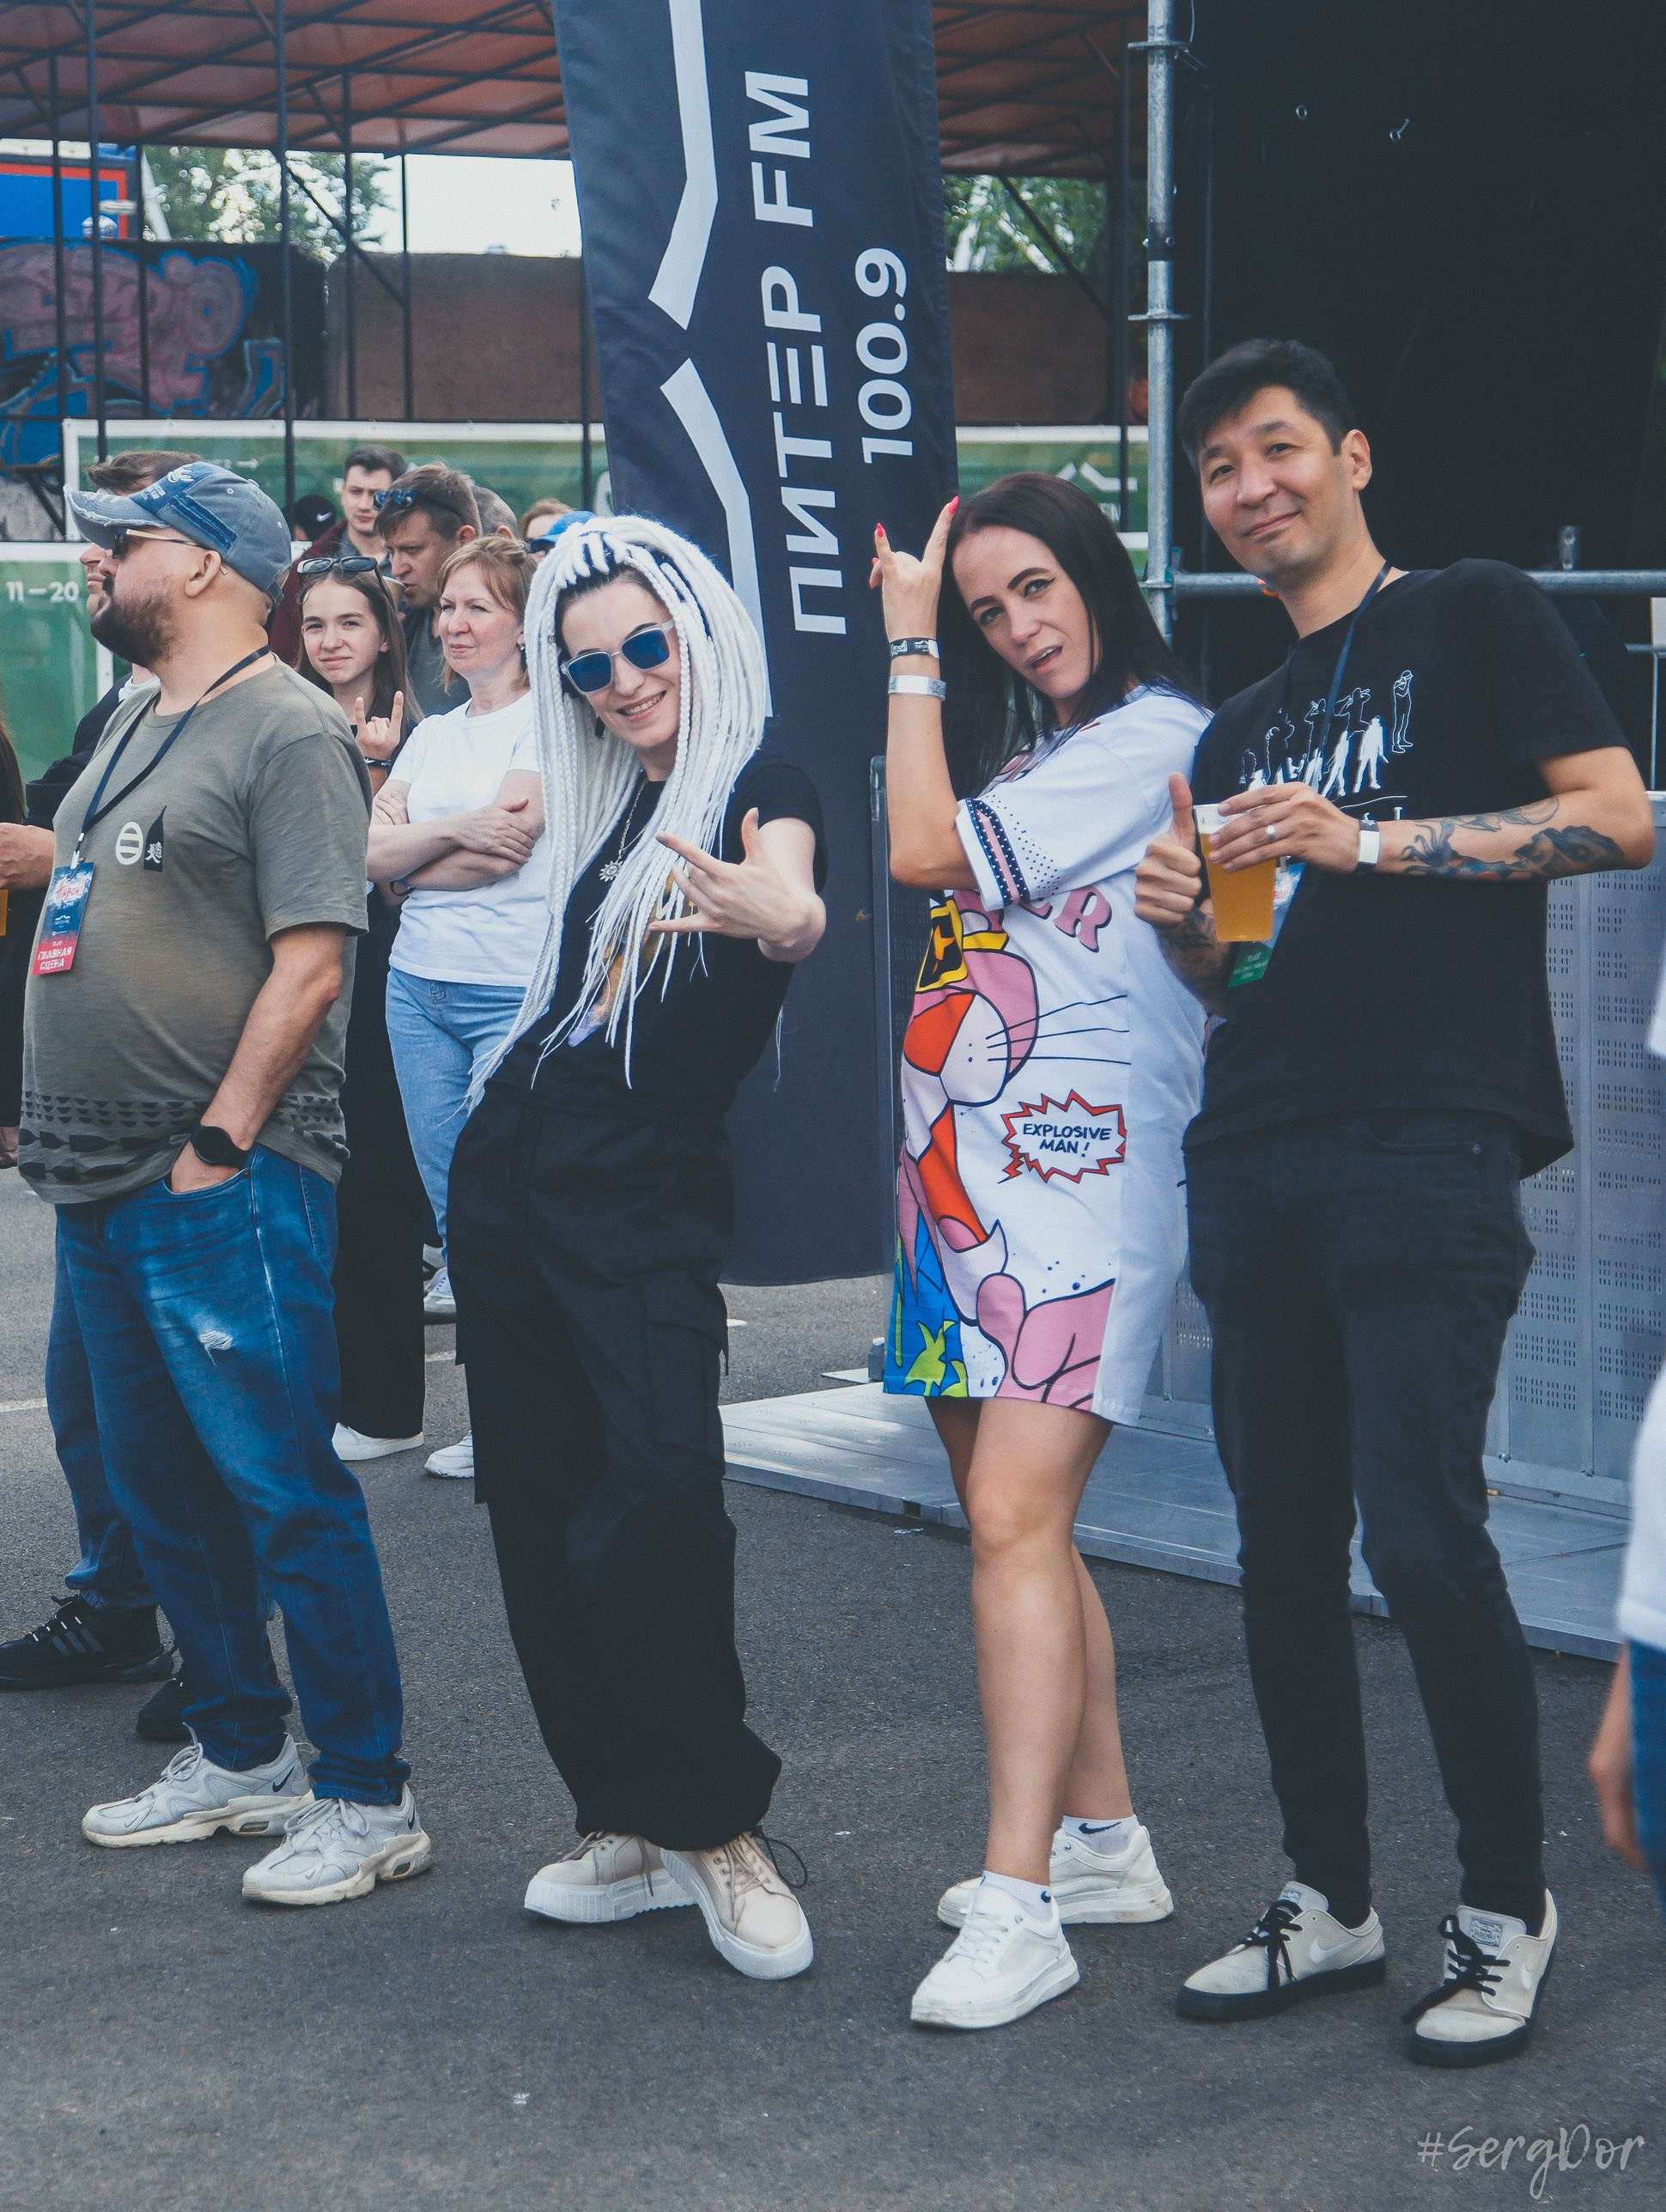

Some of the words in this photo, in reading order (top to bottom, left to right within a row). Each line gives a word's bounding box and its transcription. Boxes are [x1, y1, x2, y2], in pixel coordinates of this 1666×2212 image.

[745, 70, 814, 228] FM
[854, 247, 914, 464] 100.9
[761, 265, 847, 635] ПИТЕР
[38, 945, 72, 961] ГЛАВНАЯ
[40, 957, 64, 970] СЦЕНА
[1023, 1123, 1112, 1140] EXPLOSIVE
